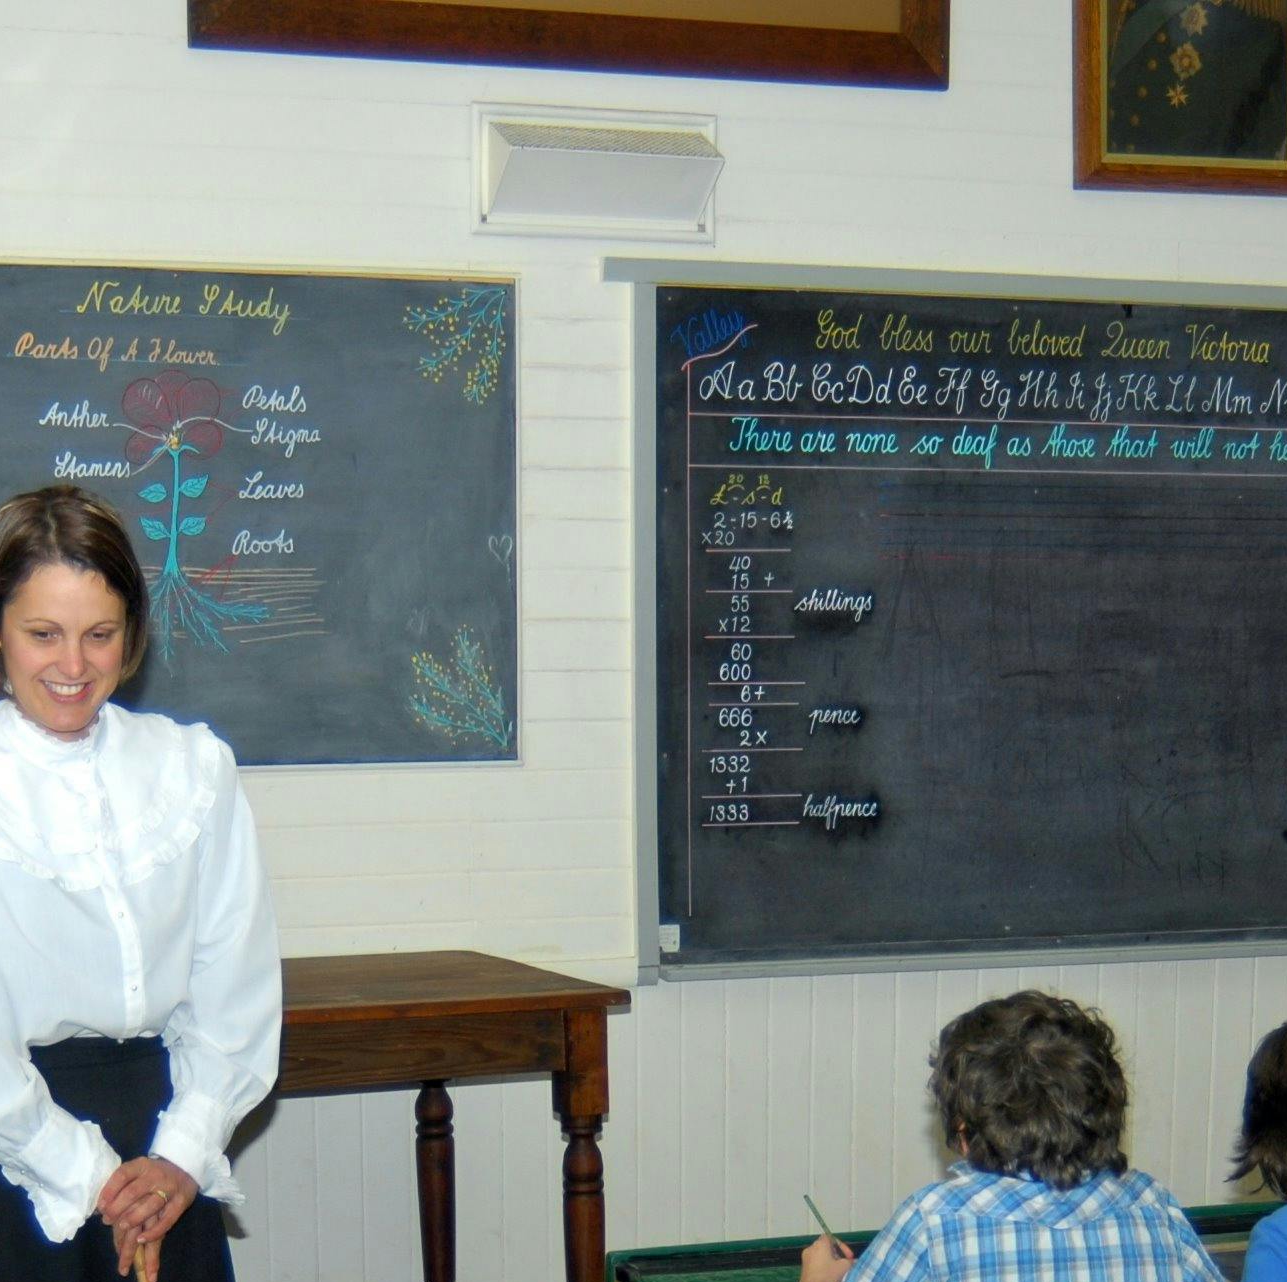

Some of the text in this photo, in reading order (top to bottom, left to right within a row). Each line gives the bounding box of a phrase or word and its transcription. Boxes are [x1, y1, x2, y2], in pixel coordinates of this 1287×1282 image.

[77, 280, 291, 335] Nature Study
[816, 309, 1270, 363] God bless our beloved Queen Victoria
[15, 331, 79, 359] Parts
[87, 336, 114, 372] Of
[122, 338, 138, 363] A
[242, 385, 307, 413] Petals
[699, 361, 755, 401] Aa
[762, 361, 803, 402] Bb
[812, 363, 844, 402] Cc
[846, 365, 893, 405] Dd
[897, 365, 927, 406] Ee
[935, 366, 971, 414] Ff
[980, 369, 1011, 420] Gg
[1018, 370, 1059, 409] Hh
[1065, 371, 1085, 410] Ii
[1089, 371, 1111, 424] Jj
[1116, 373, 1160, 411] Kk
[1164, 375, 1197, 413] Ll
[1202, 376, 1253, 414] Mm
[39, 400, 110, 428] Anther
[251, 417, 321, 458] Stigma
[730, 416, 793, 452] There
[801, 432, 836, 452] are
[846, 432, 898, 455] none
[910, 434, 944, 453] so
[952, 424, 998, 470] deaf
[1007, 436, 1031, 457] as
[1041, 423, 1096, 459] those
[1105, 425, 1159, 459] that
[1170, 427, 1214, 460] will
[1222, 431, 1260, 461] not
[55, 451, 130, 479] Stamens
[239, 471, 304, 500] Leaves
[232, 529, 294, 555] Roots
[729, 556, 751, 571] 40
[732, 573, 749, 590] 15
[731, 595, 749, 612] 55
[794, 589, 872, 623] shillings
[731, 643, 751, 661] 60
[719, 663, 751, 681] 600
[719, 708, 752, 727] 666
[809, 708, 860, 734] pence
[710, 755, 751, 773] 1332
[710, 804, 749, 822] 1333
[803, 794, 876, 830] halfpence
